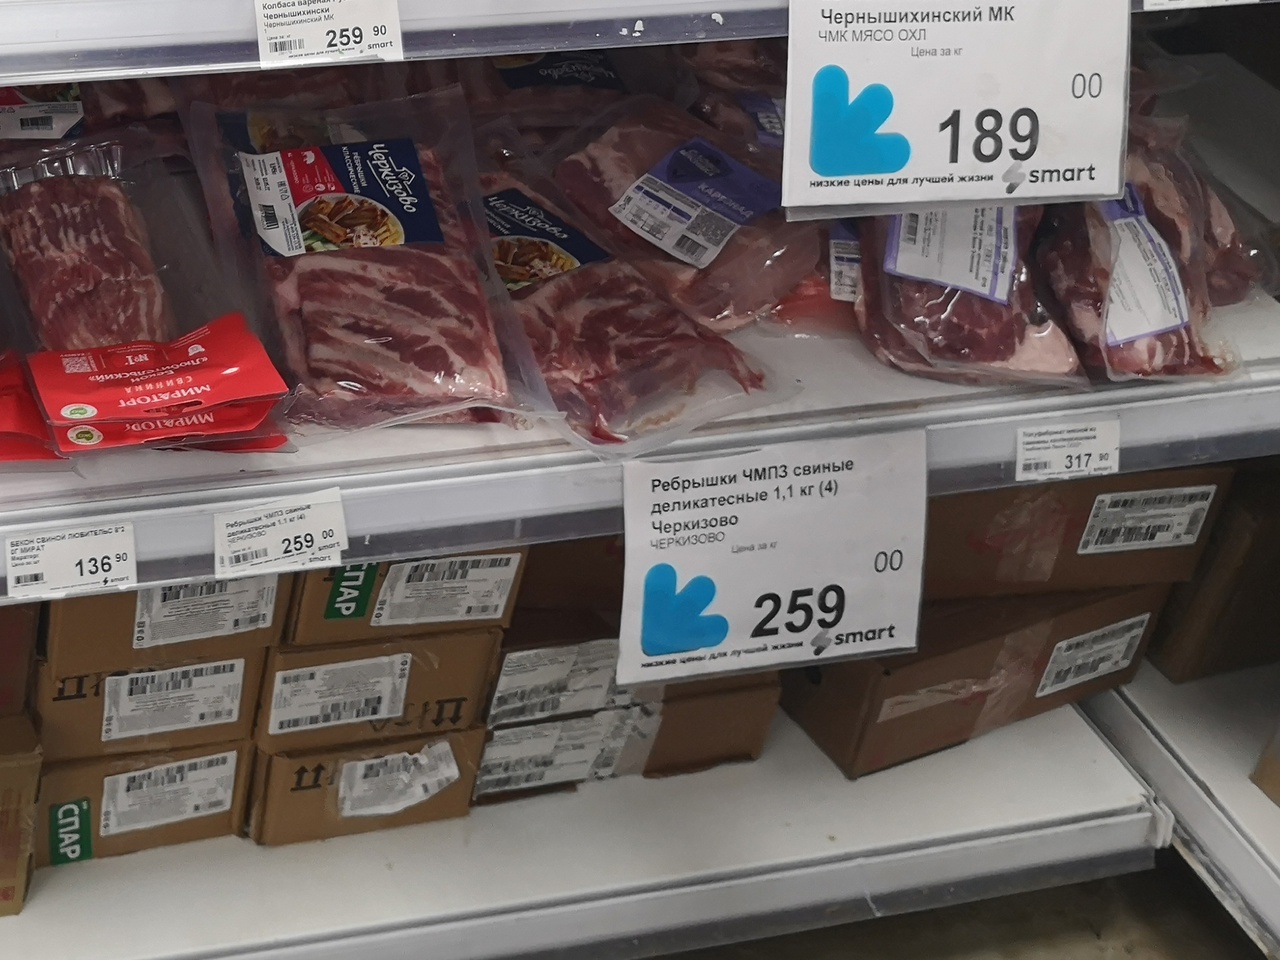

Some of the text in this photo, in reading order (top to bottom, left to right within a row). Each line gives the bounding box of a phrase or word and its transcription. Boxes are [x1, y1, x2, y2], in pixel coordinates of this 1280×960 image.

[262, 0, 296, 11] Колбаса
[263, 7, 330, 20] Чернышихински
[821, 6, 1016, 28] Чернышихинский МК
[326, 25, 387, 49] 259 90
[367, 41, 394, 50] smart
[818, 29, 927, 43] ЧМК МЯСО ОХЛ
[911, 46, 963, 58] Цена за кг
[938, 72, 1103, 164] 189 00
[367, 143, 419, 214] Черкизово
[809, 173, 994, 188] низкие цены для лучшей жизни
[1028, 164, 1096, 185] smart
[118, 384, 211, 408] МИРАТОРГ
[1065, 453, 1092, 469] 317
[651, 459, 855, 494] Ребрышки ЧМПЗ свиные
[650, 479, 839, 516] деликатесные 1,1 кг (4)
[652, 515, 739, 536] Черкизово
[10, 538, 35, 548] БЕКОН
[282, 529, 334, 555] 259 00
[650, 531, 725, 551] ЧЕРКИЗОВО
[75, 552, 128, 577] 136 90
[750, 549, 903, 640] 259 00
[835, 624, 896, 645] smart
[57, 804, 81, 859] СПАР
